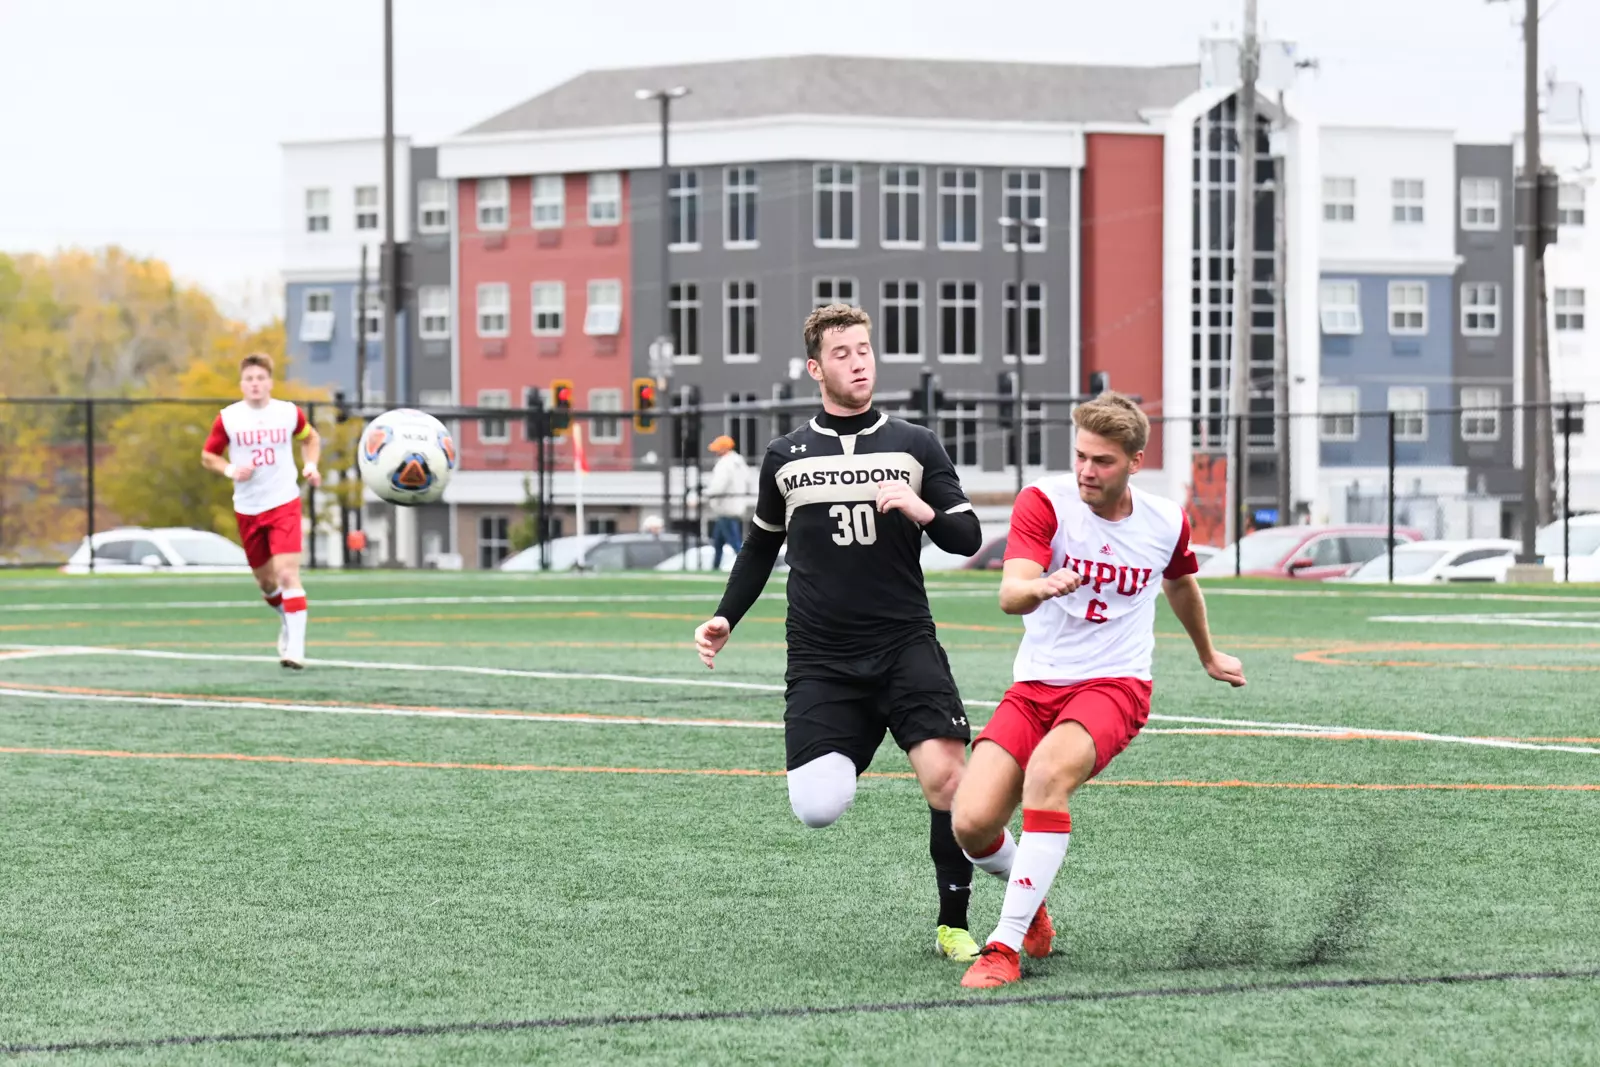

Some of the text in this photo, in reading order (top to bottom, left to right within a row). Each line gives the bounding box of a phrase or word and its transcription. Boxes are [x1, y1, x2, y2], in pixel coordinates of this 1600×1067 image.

[235, 428, 287, 447] IUPUI
[252, 447, 276, 467] 20
[783, 468, 911, 491] MASTODONS
[829, 503, 877, 546] 30
[1085, 598, 1108, 624] 6
